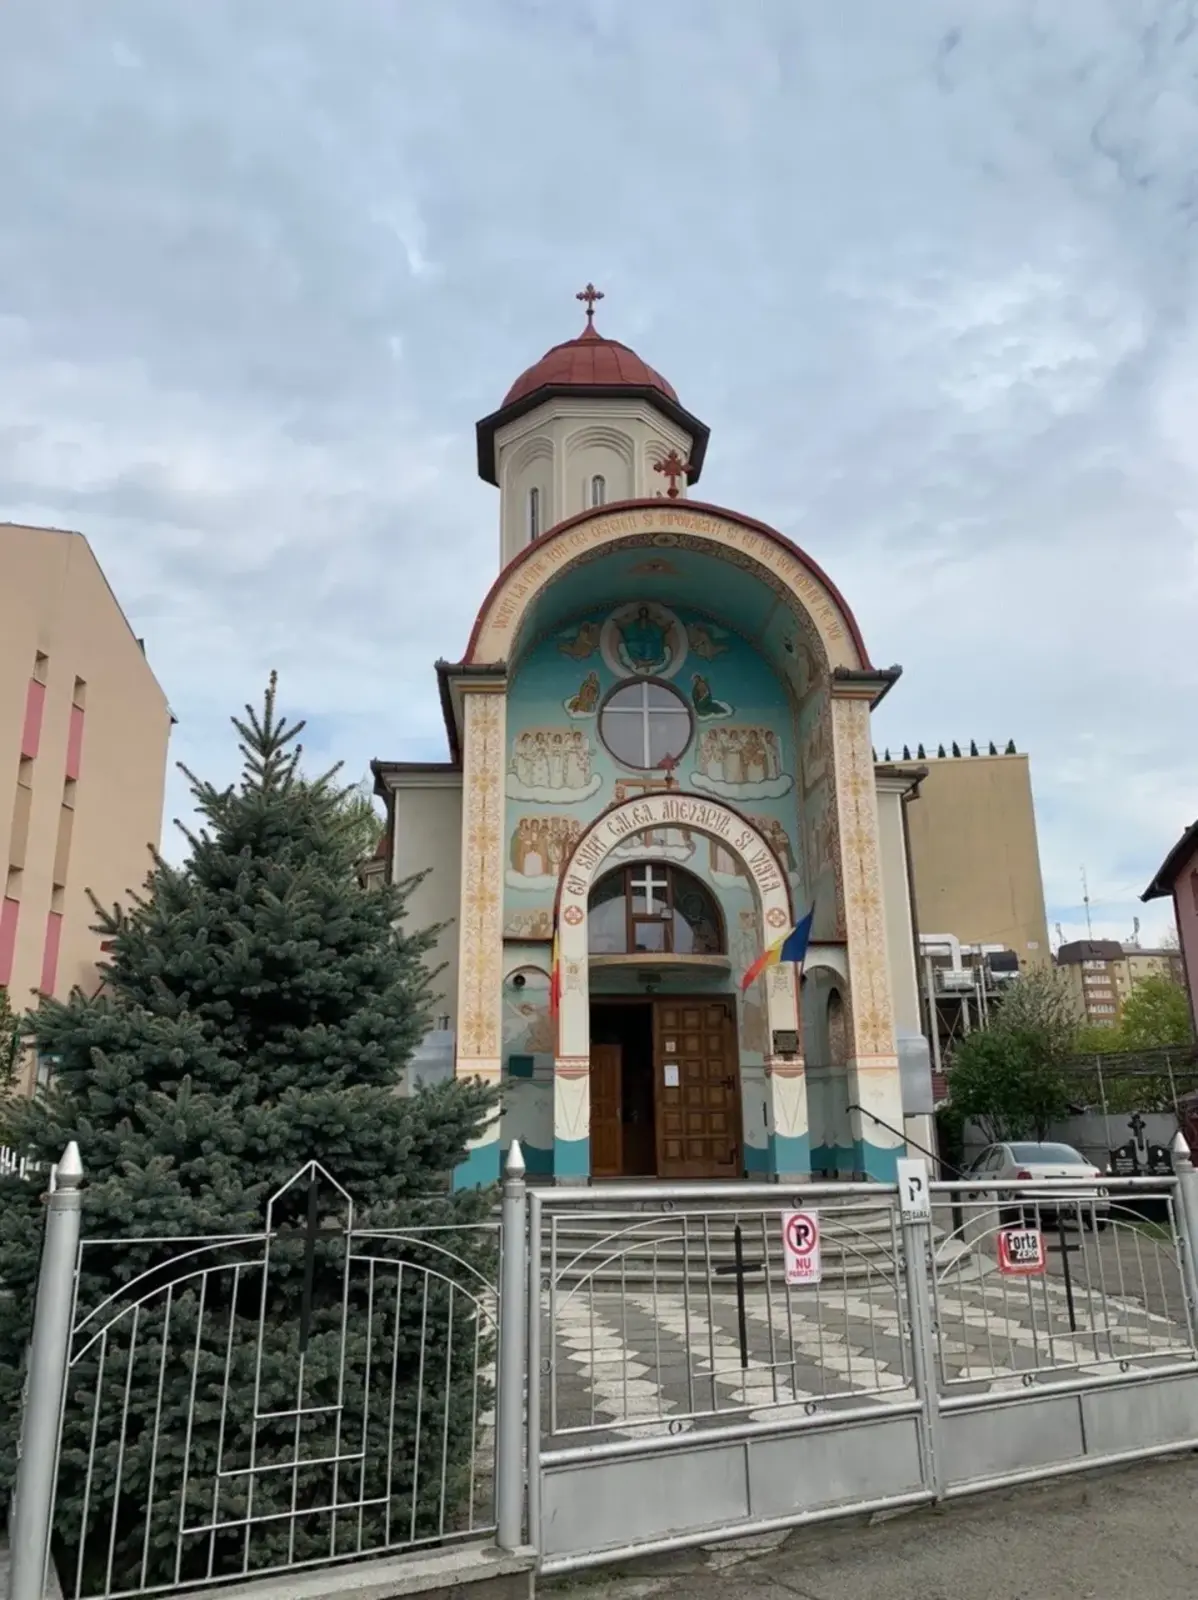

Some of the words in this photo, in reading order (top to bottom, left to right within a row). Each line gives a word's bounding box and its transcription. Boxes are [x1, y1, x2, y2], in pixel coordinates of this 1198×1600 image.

[576, 835, 608, 871] SUNT
[566, 874, 587, 896] EU
[1006, 1232, 1038, 1250] Forta
[796, 1257, 811, 1269] NU
